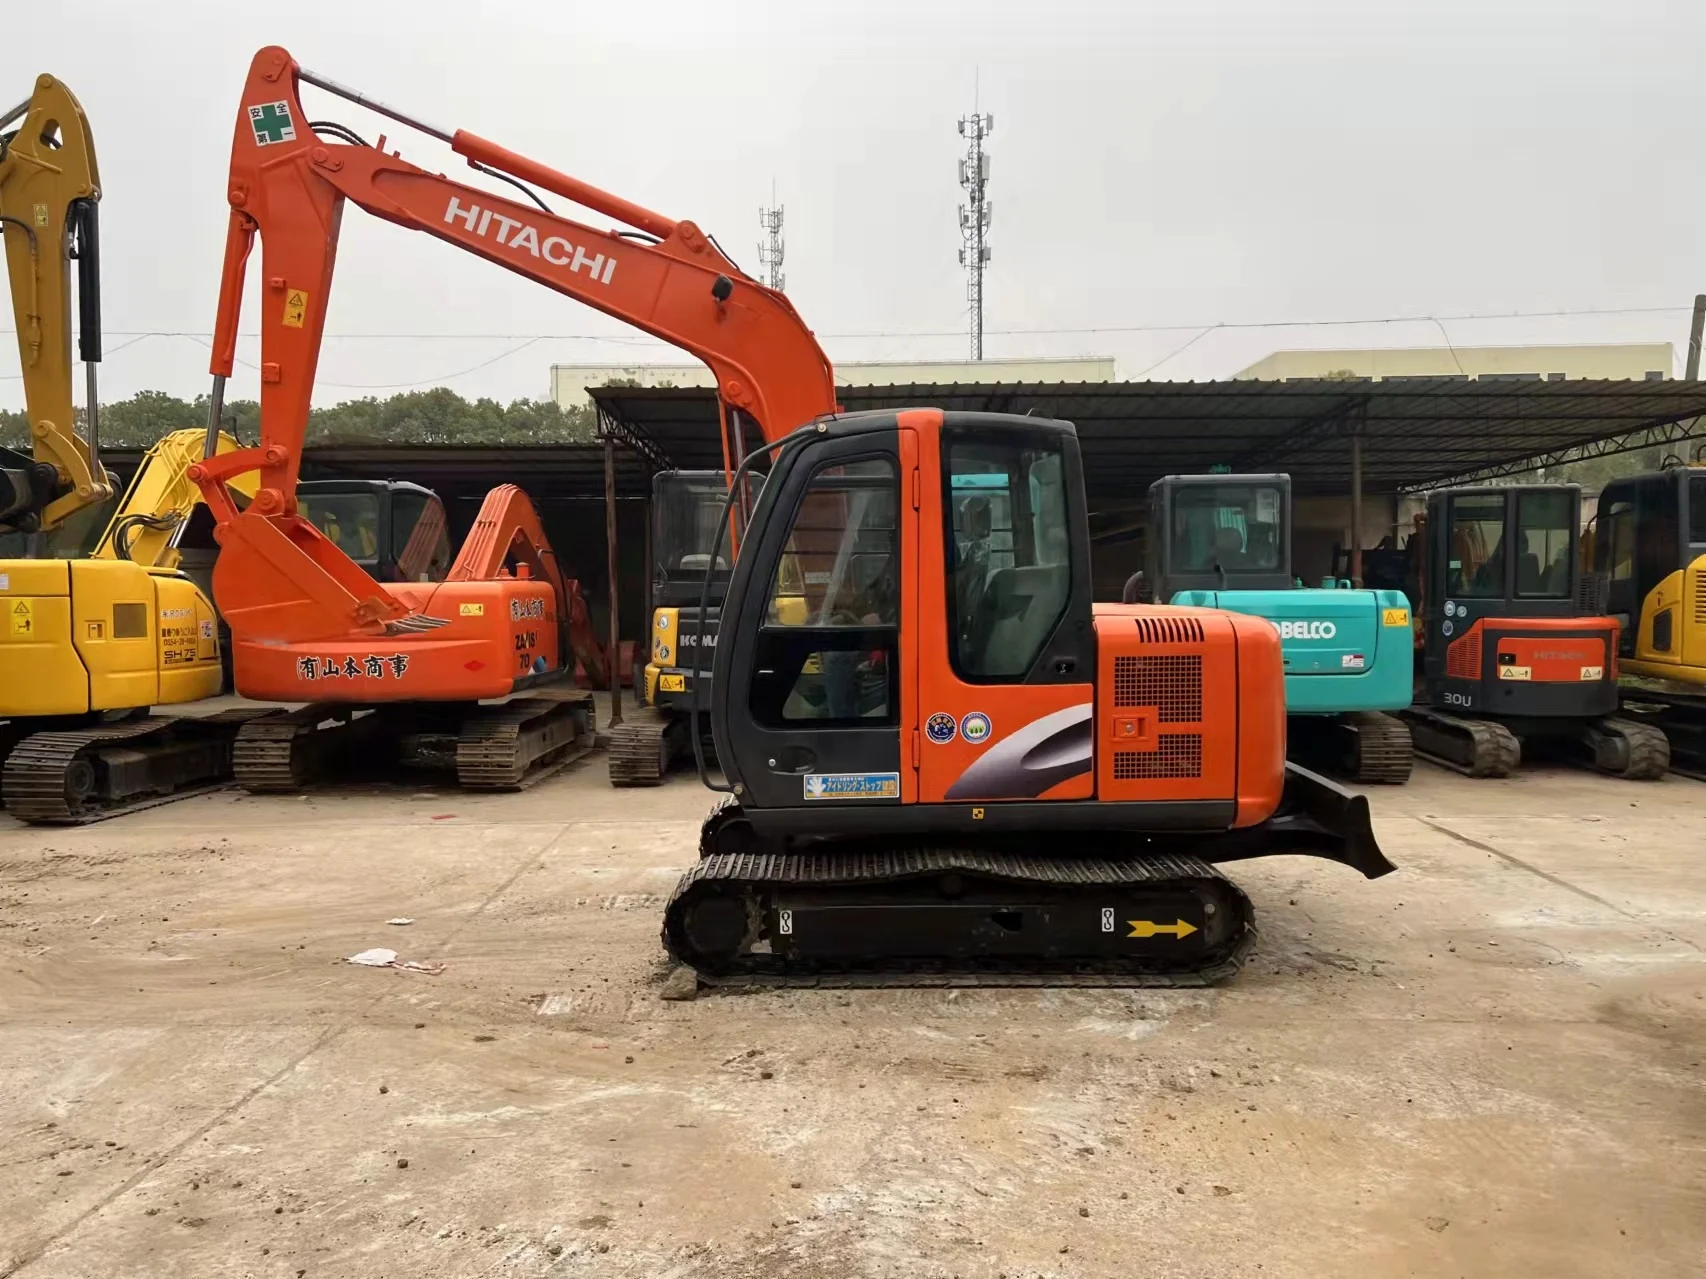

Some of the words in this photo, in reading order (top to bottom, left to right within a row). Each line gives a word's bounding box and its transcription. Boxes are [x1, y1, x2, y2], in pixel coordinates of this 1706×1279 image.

[444, 196, 617, 285] HITACHI
[164, 650, 182, 659] SH
[183, 648, 196, 657] 75
[519, 653, 530, 669] 70
[297, 653, 410, 680] (有)山本商事
[1443, 691, 1472, 708] 30U
